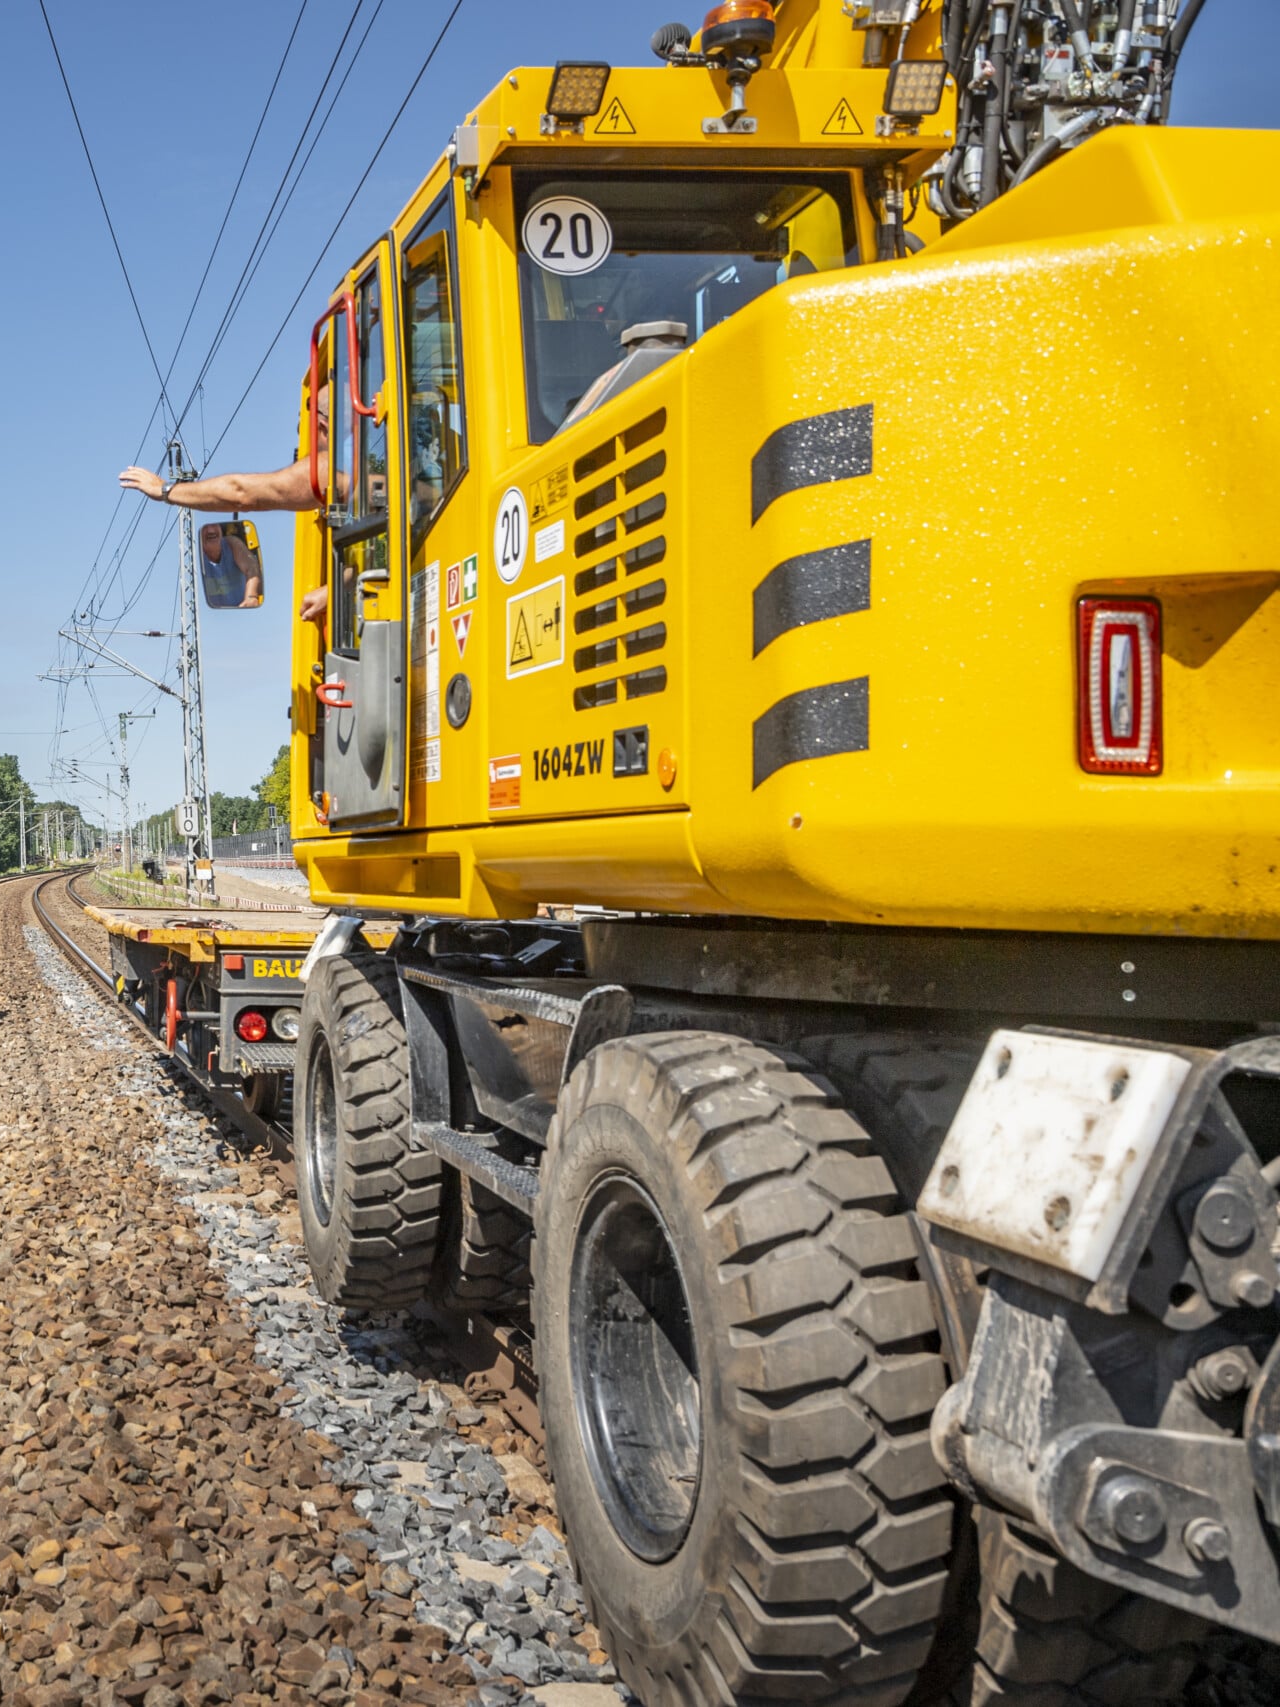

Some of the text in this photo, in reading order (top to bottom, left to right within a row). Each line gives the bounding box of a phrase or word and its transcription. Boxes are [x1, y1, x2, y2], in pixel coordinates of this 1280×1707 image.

[540, 212, 593, 258] 20
[502, 505, 520, 566] 20
[533, 739, 605, 781] 1604ZW
[184, 806, 193, 818] 11
[253, 959, 307, 978] BAU
